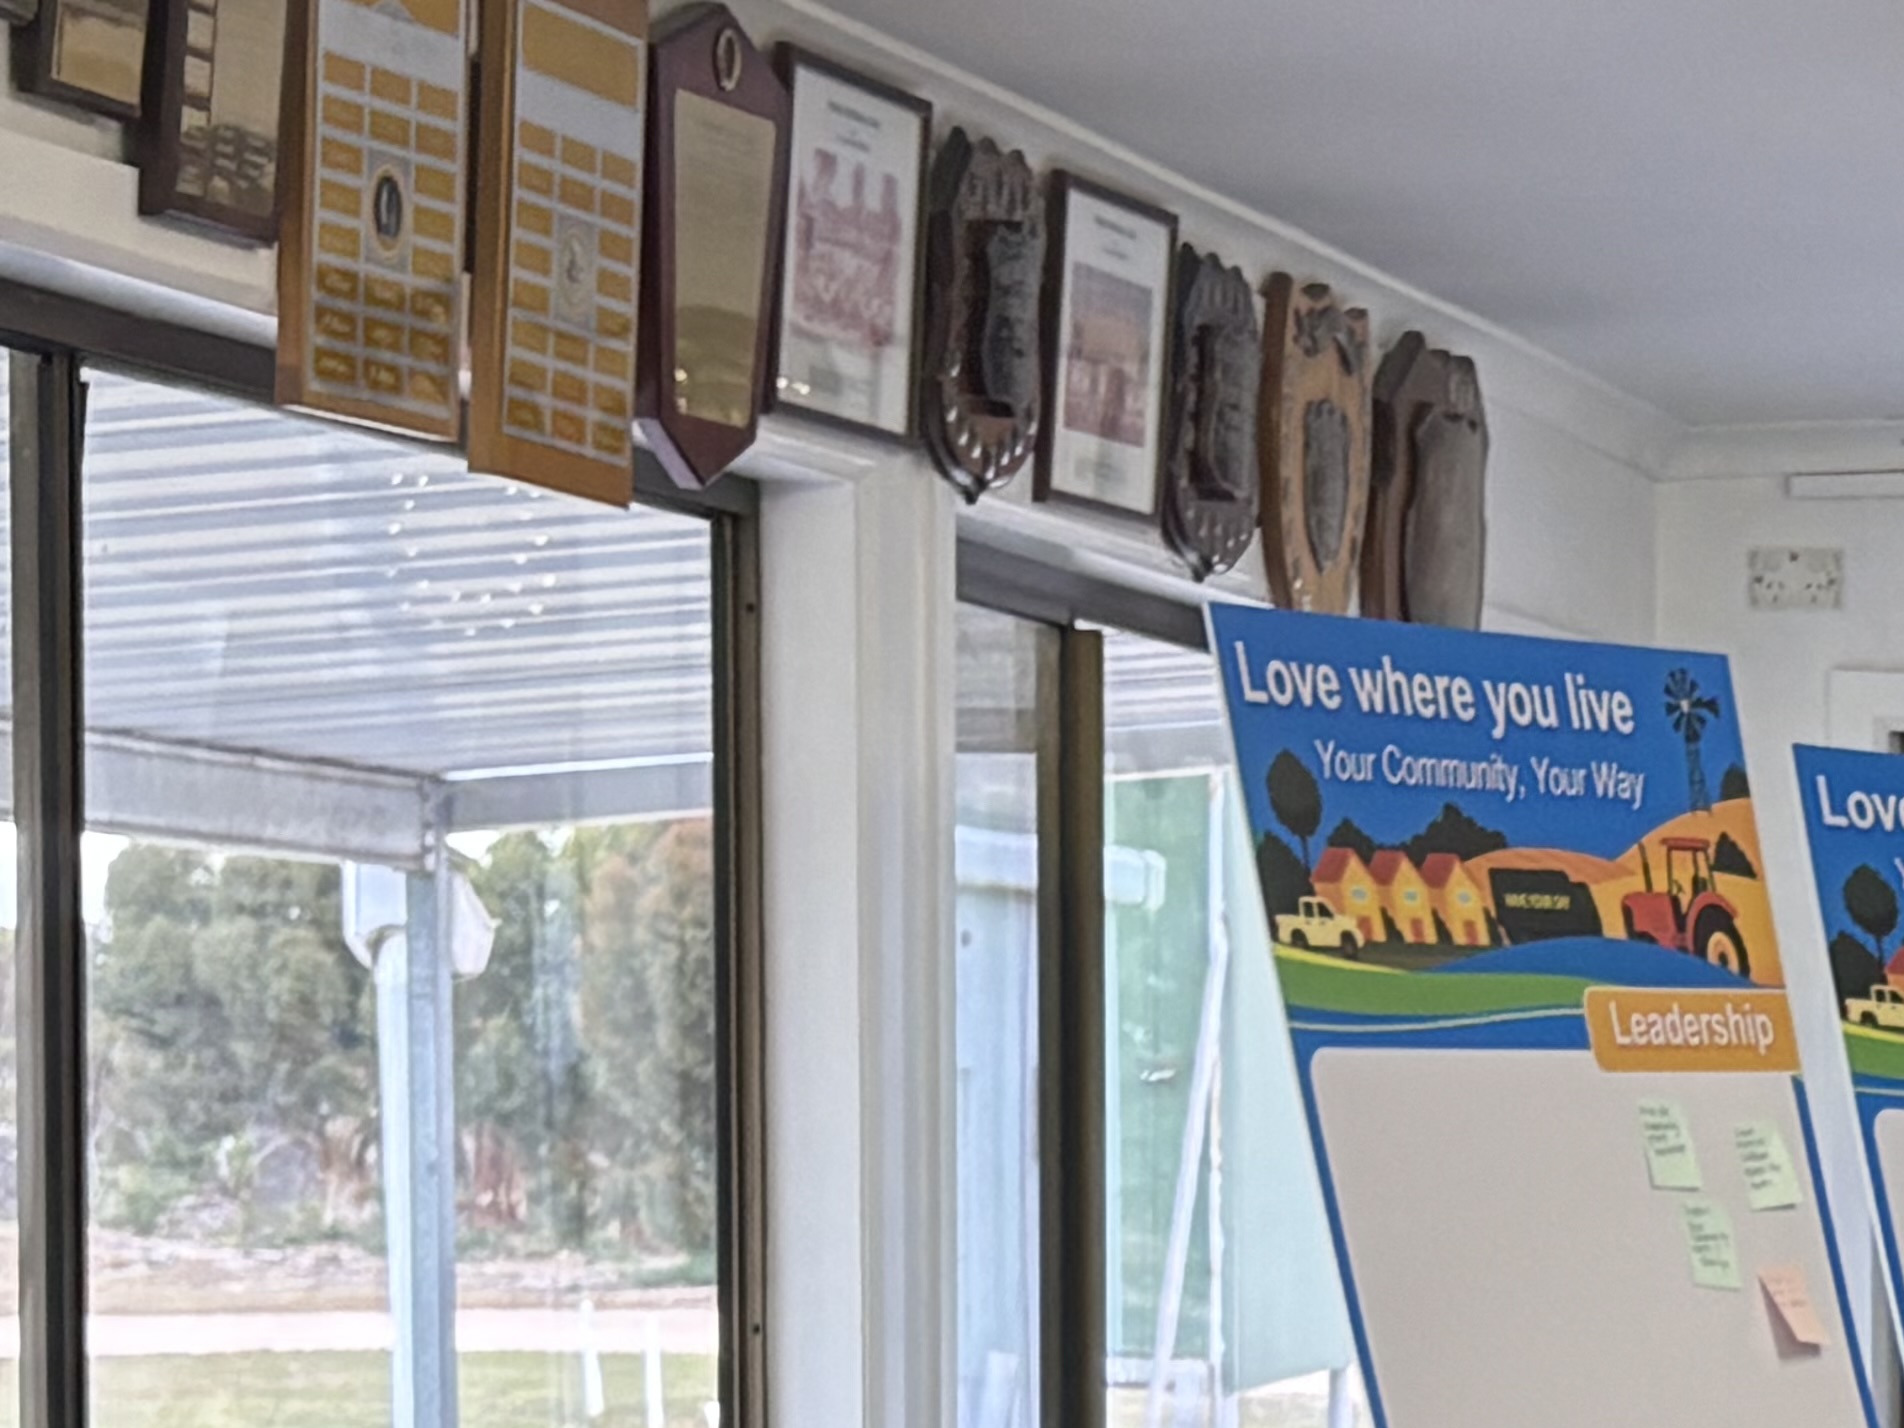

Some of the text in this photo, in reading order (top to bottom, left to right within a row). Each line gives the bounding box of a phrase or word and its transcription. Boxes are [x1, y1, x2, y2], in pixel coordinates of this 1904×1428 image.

[1234, 639, 1635, 740] Love where you live
[1313, 738, 1645, 810] Your Community, Your Way
[1607, 999, 1776, 1056] Leadership
